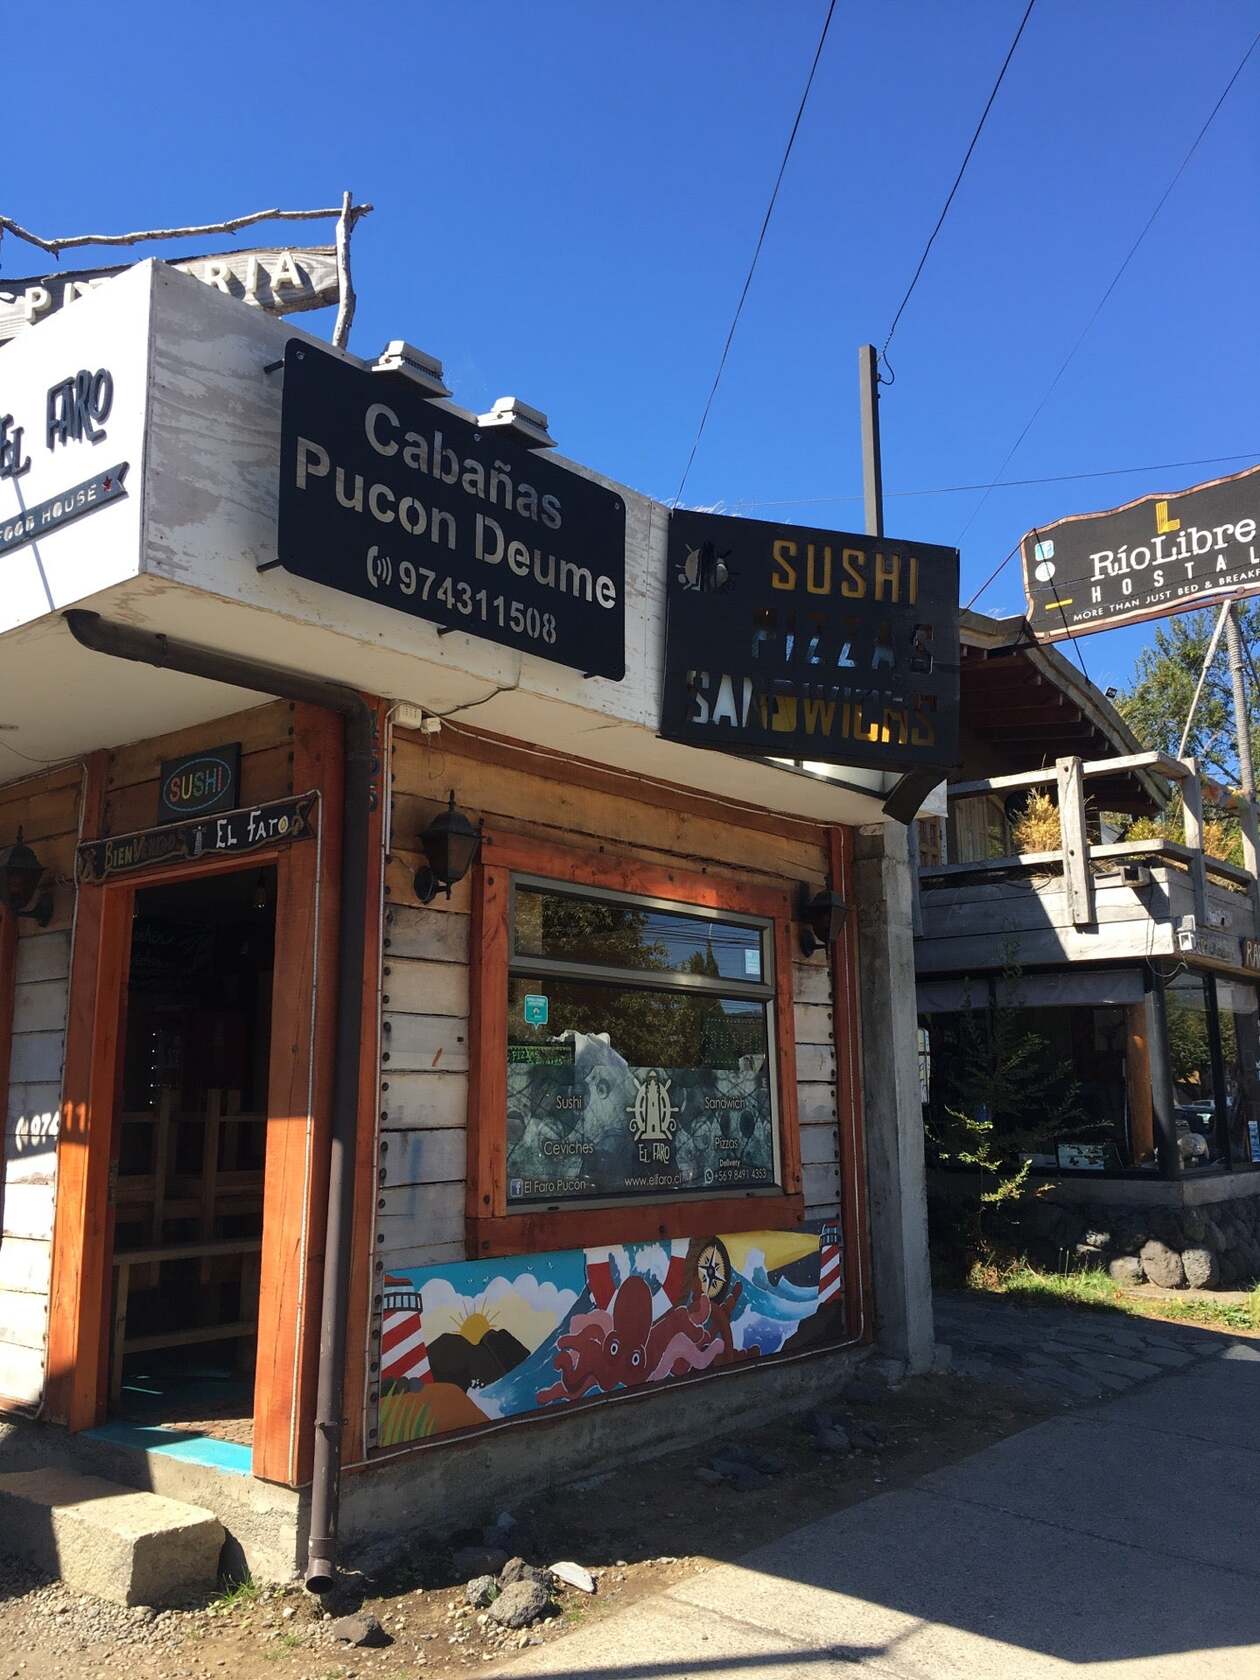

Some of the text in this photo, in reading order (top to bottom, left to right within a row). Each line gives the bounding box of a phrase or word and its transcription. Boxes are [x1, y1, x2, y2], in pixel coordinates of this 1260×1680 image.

[47, 368, 114, 452] FARO
[364, 403, 562, 530] Cabañas
[42, 484, 97, 524] HOUSE
[295, 435, 616, 609] Pucon Deume
[1089, 518, 1257, 582] RíoLibre
[771, 539, 920, 605] SUSHI
[399, 561, 557, 645] 974311508
[1073, 607, 1104, 622] MORE
[1109, 600, 1140, 615] THAN
[1145, 590, 1171, 604] JUST
[1177, 584, 1198, 596] BED
[1204, 580, 1213, 589] &
[752, 607, 934, 675] PIZZAS
[169, 766, 223, 802] SUSHI
[216, 818, 238, 849] EL
[556, 1095, 582, 1110] Sushi
[543, 1140, 595, 1156] Ceviches
[638, 1142, 670, 1165] EL FARO
[714, 1136, 739, 1149] Pizzas
[524, 1180, 532, 1194] El
[534, 1180, 555, 1193] Faro
